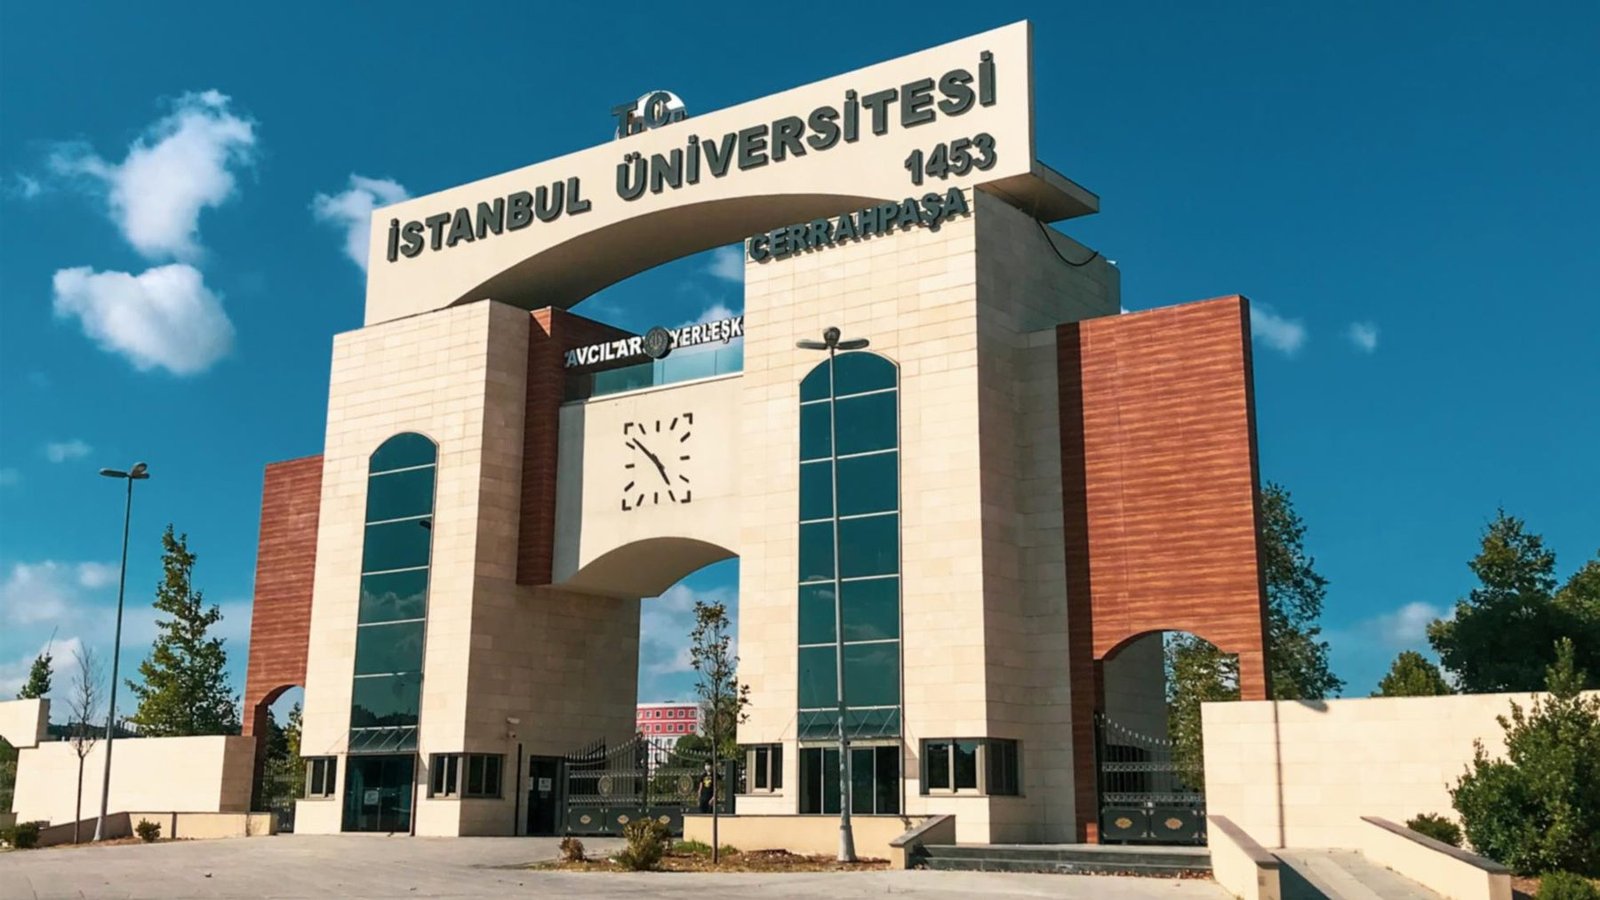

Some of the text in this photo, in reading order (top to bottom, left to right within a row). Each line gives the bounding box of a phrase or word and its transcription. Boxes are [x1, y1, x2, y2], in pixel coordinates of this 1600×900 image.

[386, 50, 997, 263] İSTANBUL ÜNİVERSİTESİ
[904, 132, 998, 186] 1453
[749, 187, 970, 263] CERRAHPAŞA
[564, 316, 744, 368] AVCILAR YERLEŞK
